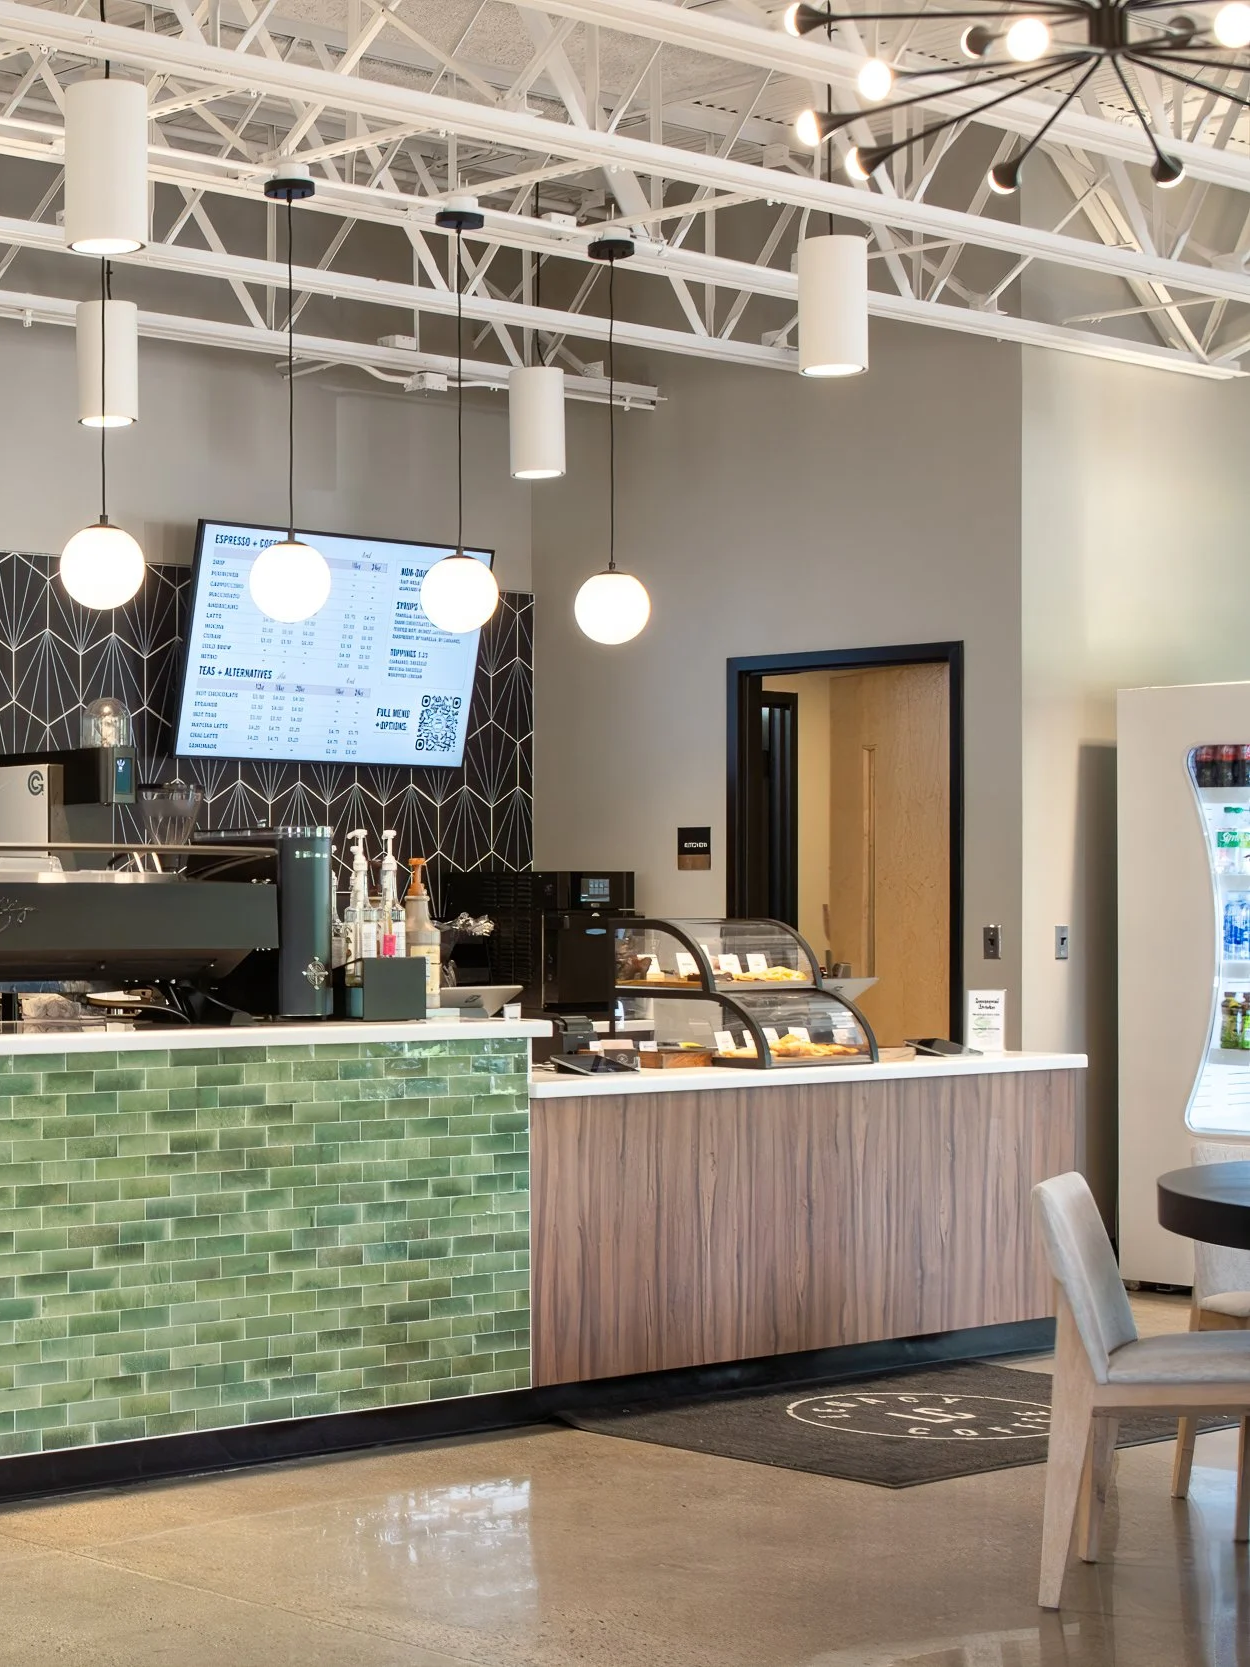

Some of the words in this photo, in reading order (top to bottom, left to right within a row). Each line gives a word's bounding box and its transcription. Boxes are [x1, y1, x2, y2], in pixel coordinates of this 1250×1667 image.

[215, 534, 251, 547] ESPRESSO
[199, 665, 216, 676] TEAS
[224, 667, 272, 679] ALTERNATIVES
[376, 707, 391, 717] FULL
[393, 708, 411, 718] MENU
